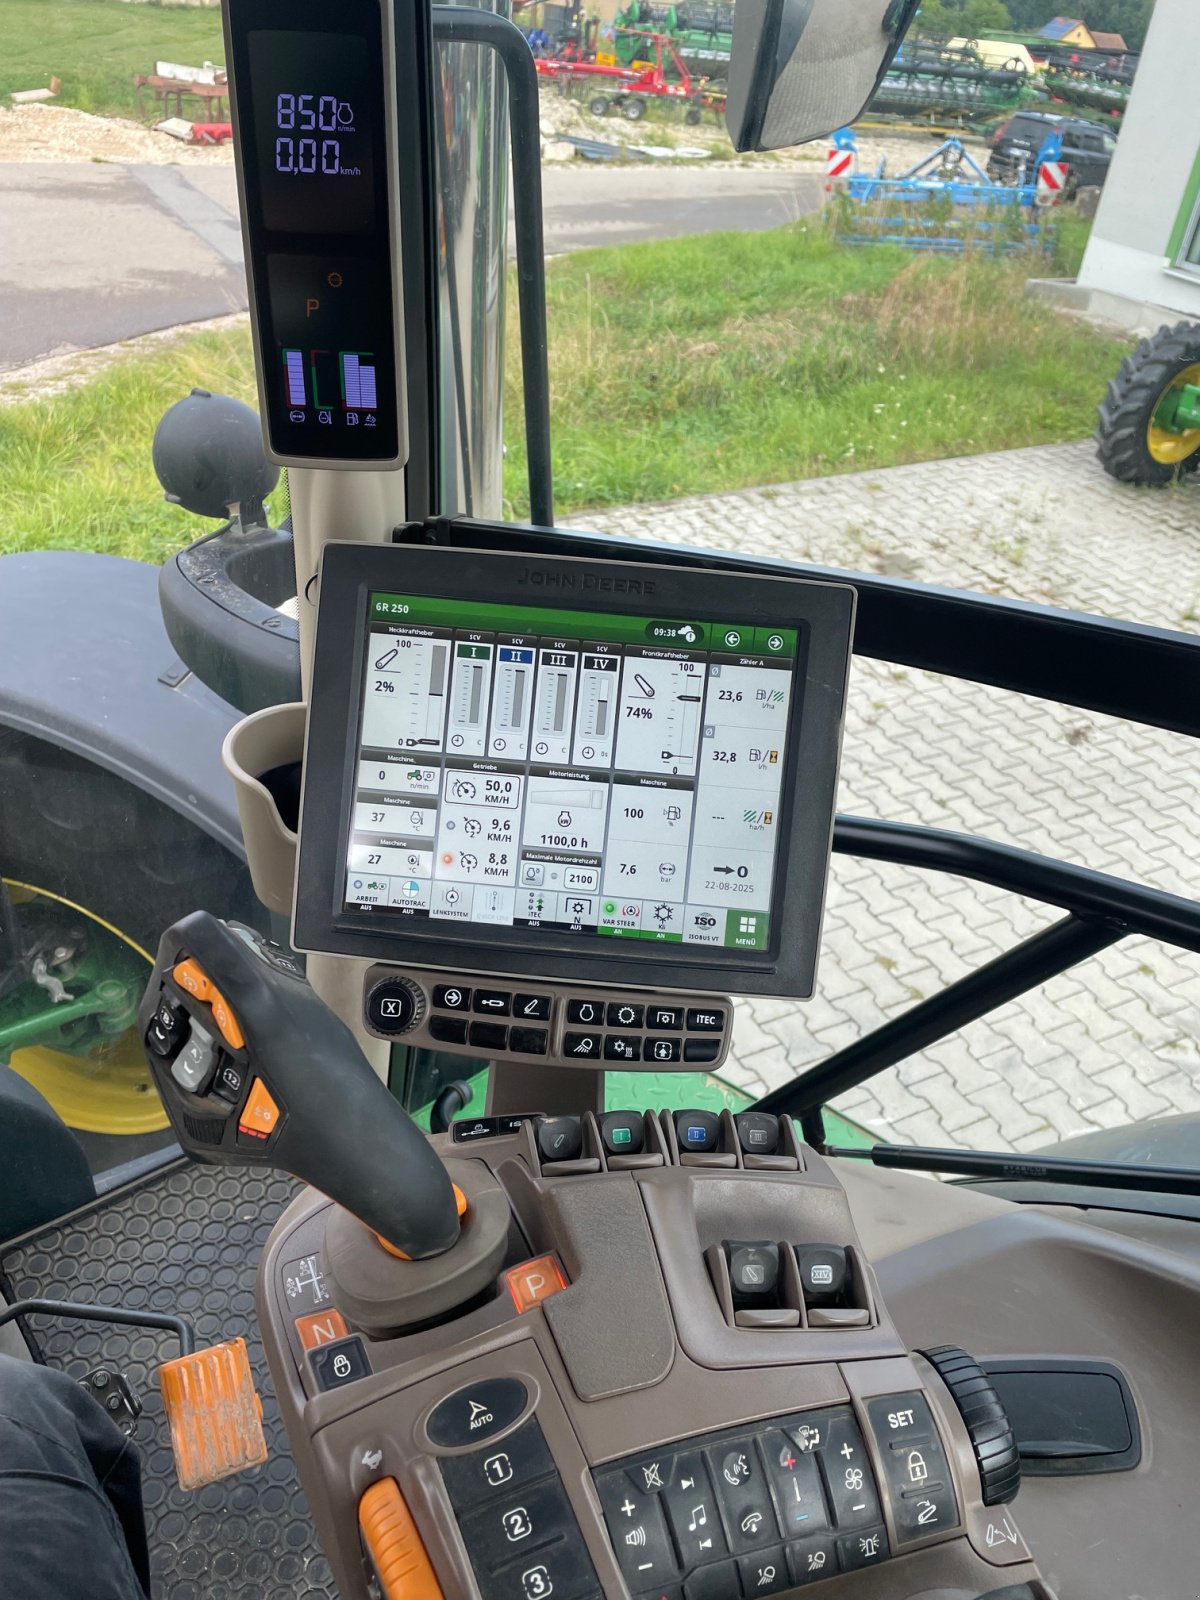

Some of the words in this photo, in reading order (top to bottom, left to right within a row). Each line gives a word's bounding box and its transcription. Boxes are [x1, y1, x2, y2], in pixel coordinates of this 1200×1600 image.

[277, 93, 337, 131] 850
[276, 137, 340, 175] 0,00
[340, 166, 361, 176] km/h
[306, 298, 320, 318] P
[517, 567, 576, 588] JOHN
[581, 572, 656, 595] DEERE
[375, 602, 389, 613] 6R
[391, 603, 409, 614] 250
[653, 627, 677, 637] 09:38
[396, 640, 412, 649] 100
[510, 652, 521, 662] II
[550, 656, 567, 666] III
[592, 659, 610, 669] IV
[678, 663, 694, 672] 100
[375, 681, 395, 693] 2%
[718, 690, 743, 703] 23,6
[626, 706, 653, 720] 74%
[398, 738, 404, 746] 0
[712, 750, 737, 763] 32,8
[378, 770, 386, 780] 0
[672, 766, 678, 775] 0
[485, 780, 512, 793] 50,0
[640, 779, 667, 787] Maschine
[484, 795, 510, 805] KM/H
[371, 812, 385, 823] 37
[623, 808, 644, 819] 100
[491, 819, 511, 832] 9,6
[487, 833, 512, 843] KM/H
[540, 834, 578, 848] 1100,0
[581, 837, 588, 848] h
[368, 854, 382, 865] 27
[488, 853, 508, 865] 8,8
[484, 868, 510, 877] KM/H
[619, 864, 637, 876] 7,6
[569, 874, 593, 885] 2100
[705, 880, 755, 893] 22-08-2025
[356, 895, 378, 903] ARBEIT
[392, 898, 426, 907] AUTOTRAC
[432, 909, 469, 918] LENKSYSTEM
[573, 916, 581, 924] N
[616, 919, 636, 928] STEER
[694, 916, 717, 927] ISO
[735, 937, 756, 946] MENÜ
[385, 1002, 396, 1013] X
[696, 1014, 716, 1026] iTEC
[227, 1072, 238, 1086] 12
[523, 1273, 546, 1299] P
[311, 1318, 337, 1345] N
[469, 1413, 493, 1430] AUTO
[887, 1409, 915, 1429] SET
[493, 1461, 505, 1479] 1
[511, 1514, 526, 1536] 2
[808, 1556, 815, 1564] 2
[758, 1569, 763, 1577] 1
[530, 1573, 546, 1595] 3
